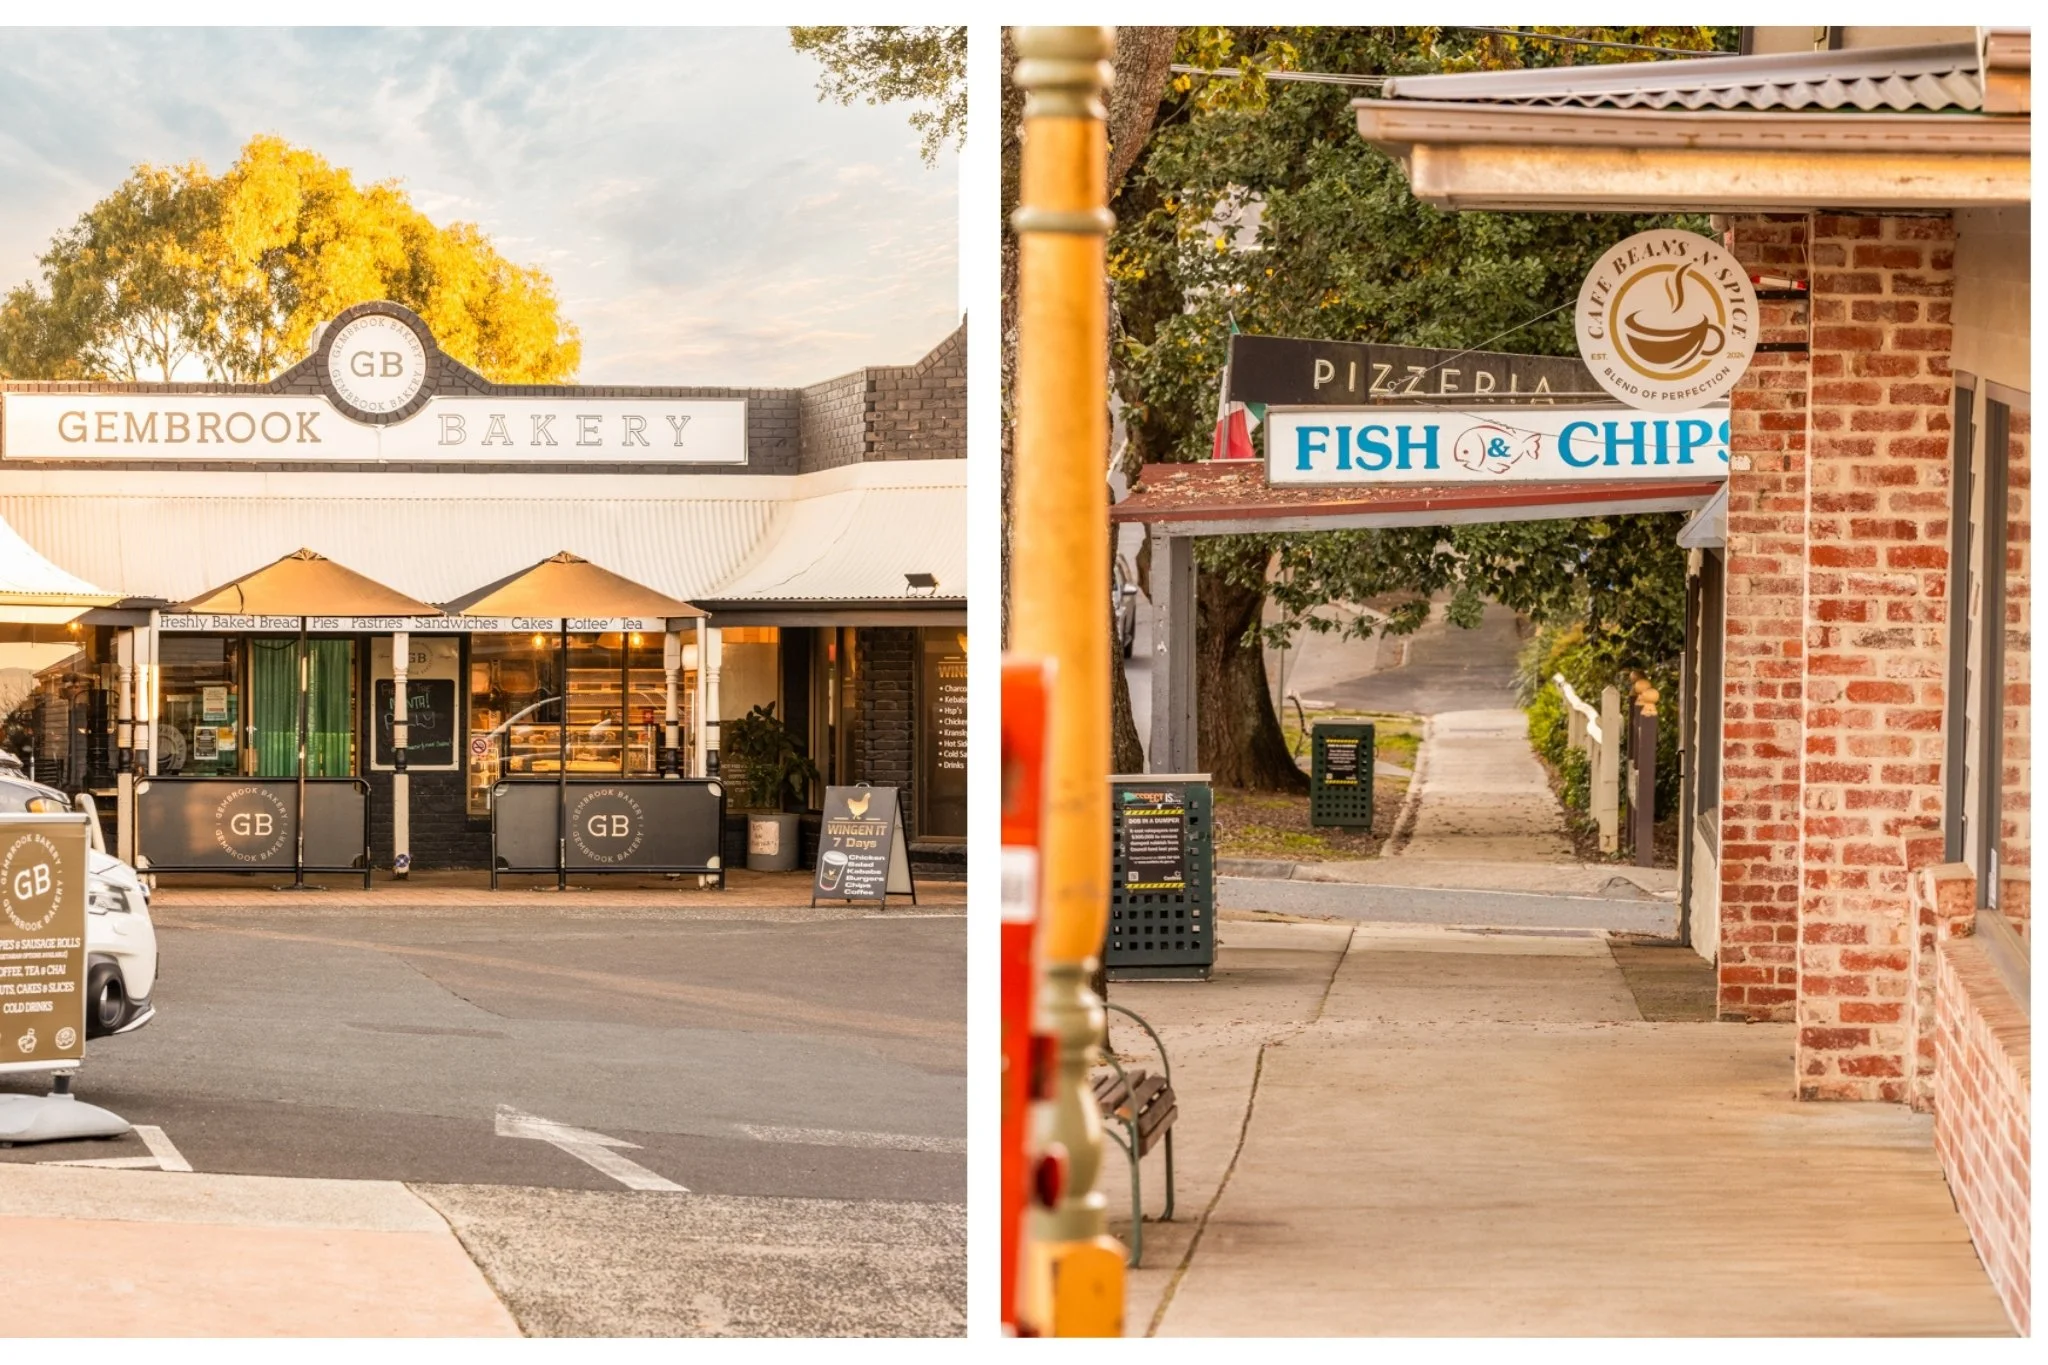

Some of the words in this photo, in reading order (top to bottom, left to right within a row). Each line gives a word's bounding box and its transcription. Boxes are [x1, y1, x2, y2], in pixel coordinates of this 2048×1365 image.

[1588, 276, 1612, 340] CAFE
[1714, 268, 1748, 339] SPICE
[332, 318, 385, 358] GEMBROOK
[390, 321, 423, 358] BAKERY
[350, 351, 403, 378] GB
[332, 370, 385, 411] GEMBROOK
[390, 370, 422, 408] BAKERY
[1314, 360, 1554, 404] PIZZERIA
[1604, 367, 1638, 395] BLEND
[1642, 390, 1657, 399] OF
[1662, 366, 1730, 400] PERFECTION
[58, 411, 321, 443] GEMBROOK
[438, 414, 691, 446] BAKERY
[1295, 425, 1442, 471] FISH
[1487, 437, 1512, 458] &
[160, 616, 208, 630] Freshly
[212, 615, 255, 628] Baked
[260, 616, 300, 628] Bread
[313, 618, 339, 628] Pies
[351, 618, 403, 628] Pastries
[415, 618, 498, 629] Sandwiches
[512, 618, 552, 629] Cakes
[621, 618, 643, 629] Tea
[216, 788, 258, 819] GEMBROOK
[261, 790, 288, 819] BAKERY
[573, 788, 614, 820] GEMBROOK
[618, 790, 644, 820] BAKERY
[231, 813, 273, 836] GB
[588, 815, 629, 837] GB
[828, 824, 873, 835] WINGEN
[876, 826, 887, 836] IT
[216, 830, 257, 862] GEMBROOK
[260, 830, 288, 860] BAKERY
[572, 831, 614, 863] GEMBROOK
[617, 831, 644, 862] BAKERY
[833, 838, 841, 848] 7
[846, 837, 877, 850] Days
[2, 834, 32, 885] GEMBROOK
[35, 834, 62, 865] BAKERY
[14, 864, 51, 900] GB
[3, 898, 43, 931] GEMBROOK
[44, 880, 63, 924] BAKERY
[21, 938, 56, 950] SAUSAGE
[57, 937, 80, 948] ROLLS
[24, 965, 40, 976] TEA
[47, 964, 66, 975] CHAI
[16, 983, 42, 994] CAKES
[48, 982, 75, 993] SLICES
[3, 1002, 25, 1014] COLD
[25, 1001, 54, 1012] DRINKS
